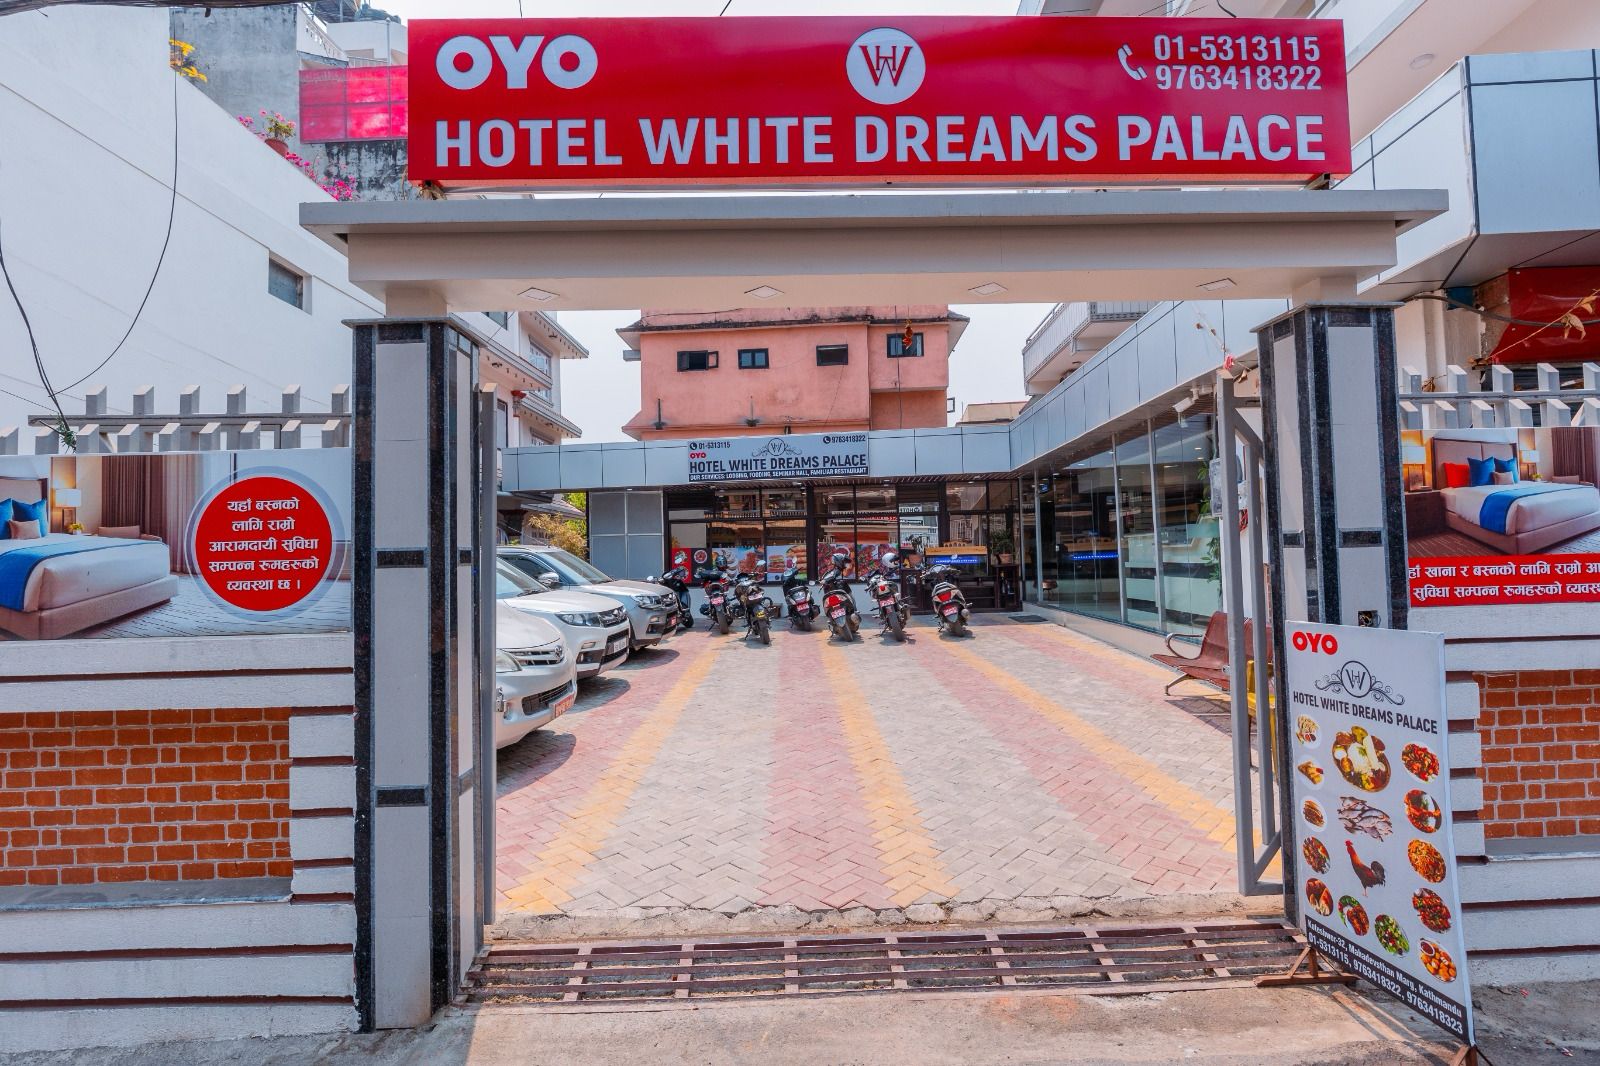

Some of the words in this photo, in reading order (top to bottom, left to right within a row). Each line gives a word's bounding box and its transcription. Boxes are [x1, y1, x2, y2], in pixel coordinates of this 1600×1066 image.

[1153, 35, 1321, 62] 01-5313115
[436, 34, 599, 90] OYO
[1156, 63, 1322, 91] 9763418322
[436, 119, 622, 168] HOTEL
[639, 116, 834, 165] WHITE
[855, 114, 1097, 164] DREAMS
[1118, 114, 1326, 162] PALACE
[832, 435, 865, 443] 9763418322
[690, 460, 726, 473] HOTEL
[729, 458, 766, 471] WHITE
[771, 456, 819, 469] DREAMS
[823, 454, 866, 467] PALACE
[256, 497, 300, 511] बस्नको
[232, 518, 263, 532] लागि
[268, 517, 295, 531] राम्रो
[209, 538, 277, 552] आरामदायी
[281, 537, 319, 552] सुविधा
[209, 560, 255, 572] सम्पन्न
[1425, 565, 1456, 578] खाना
[1460, 566, 1469, 577] र
[1473, 562, 1516, 577] बस्नको
[1520, 561, 1550, 575] लागि
[1555, 560, 1581, 574] राम्रो
[227, 580, 274, 591] व्यवस्था
[278, 580, 290, 590] छ
[1413, 585, 1450, 601] सुविधा
[1454, 585, 1499, 598] सम्पन्न
[1293, 631, 1338, 655] OYO
[1294, 691, 1319, 707] HOTEL
[1320, 697, 1349, 714] WHITE
[1352, 704, 1393, 724] DREAMS
[1396, 714, 1438, 734] PALACE
[1308, 932, 1351, 968] 01-5313115,
[1353, 960, 1405, 1001] 9763418322,
[1407, 991, 1463, 1034] 9763418323
[1419, 985, 1461, 1017] Kathmandu
